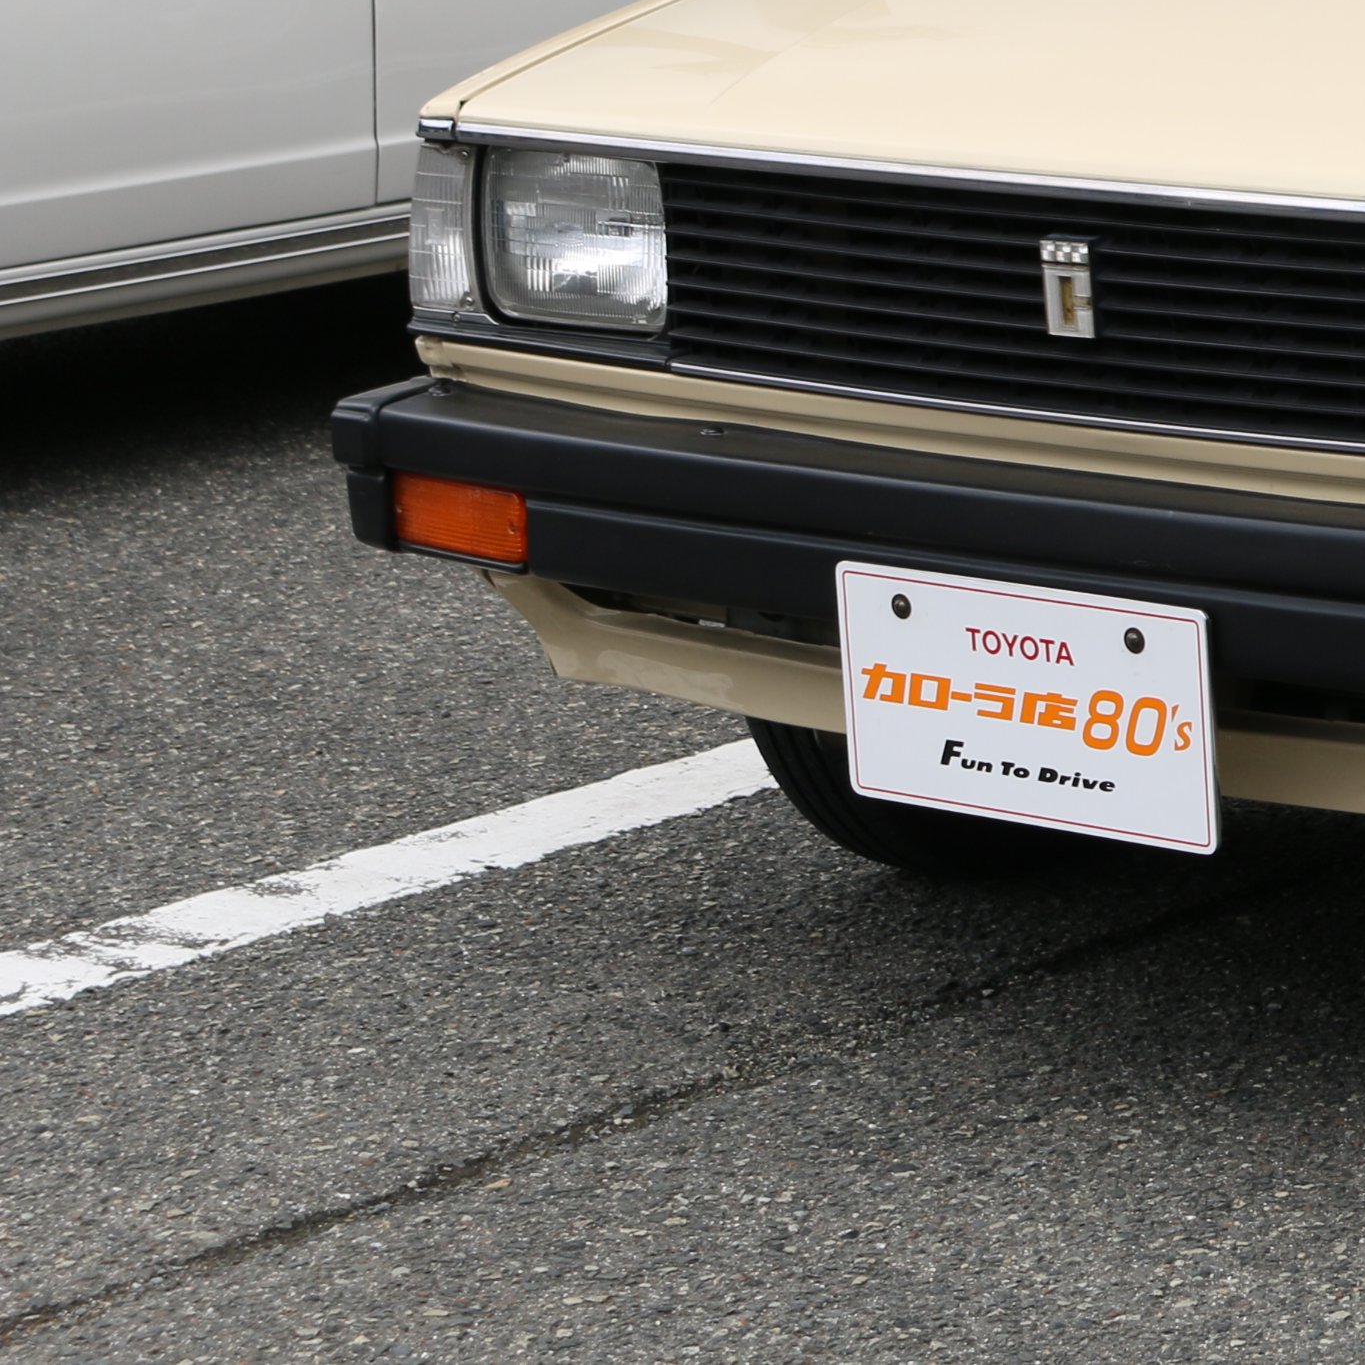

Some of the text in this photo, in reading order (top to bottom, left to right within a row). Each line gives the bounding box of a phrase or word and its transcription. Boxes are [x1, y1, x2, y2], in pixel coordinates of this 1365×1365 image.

[965, 627, 1075, 666] TOYOTA
[940, 739, 1117, 793] Fun To Drive
